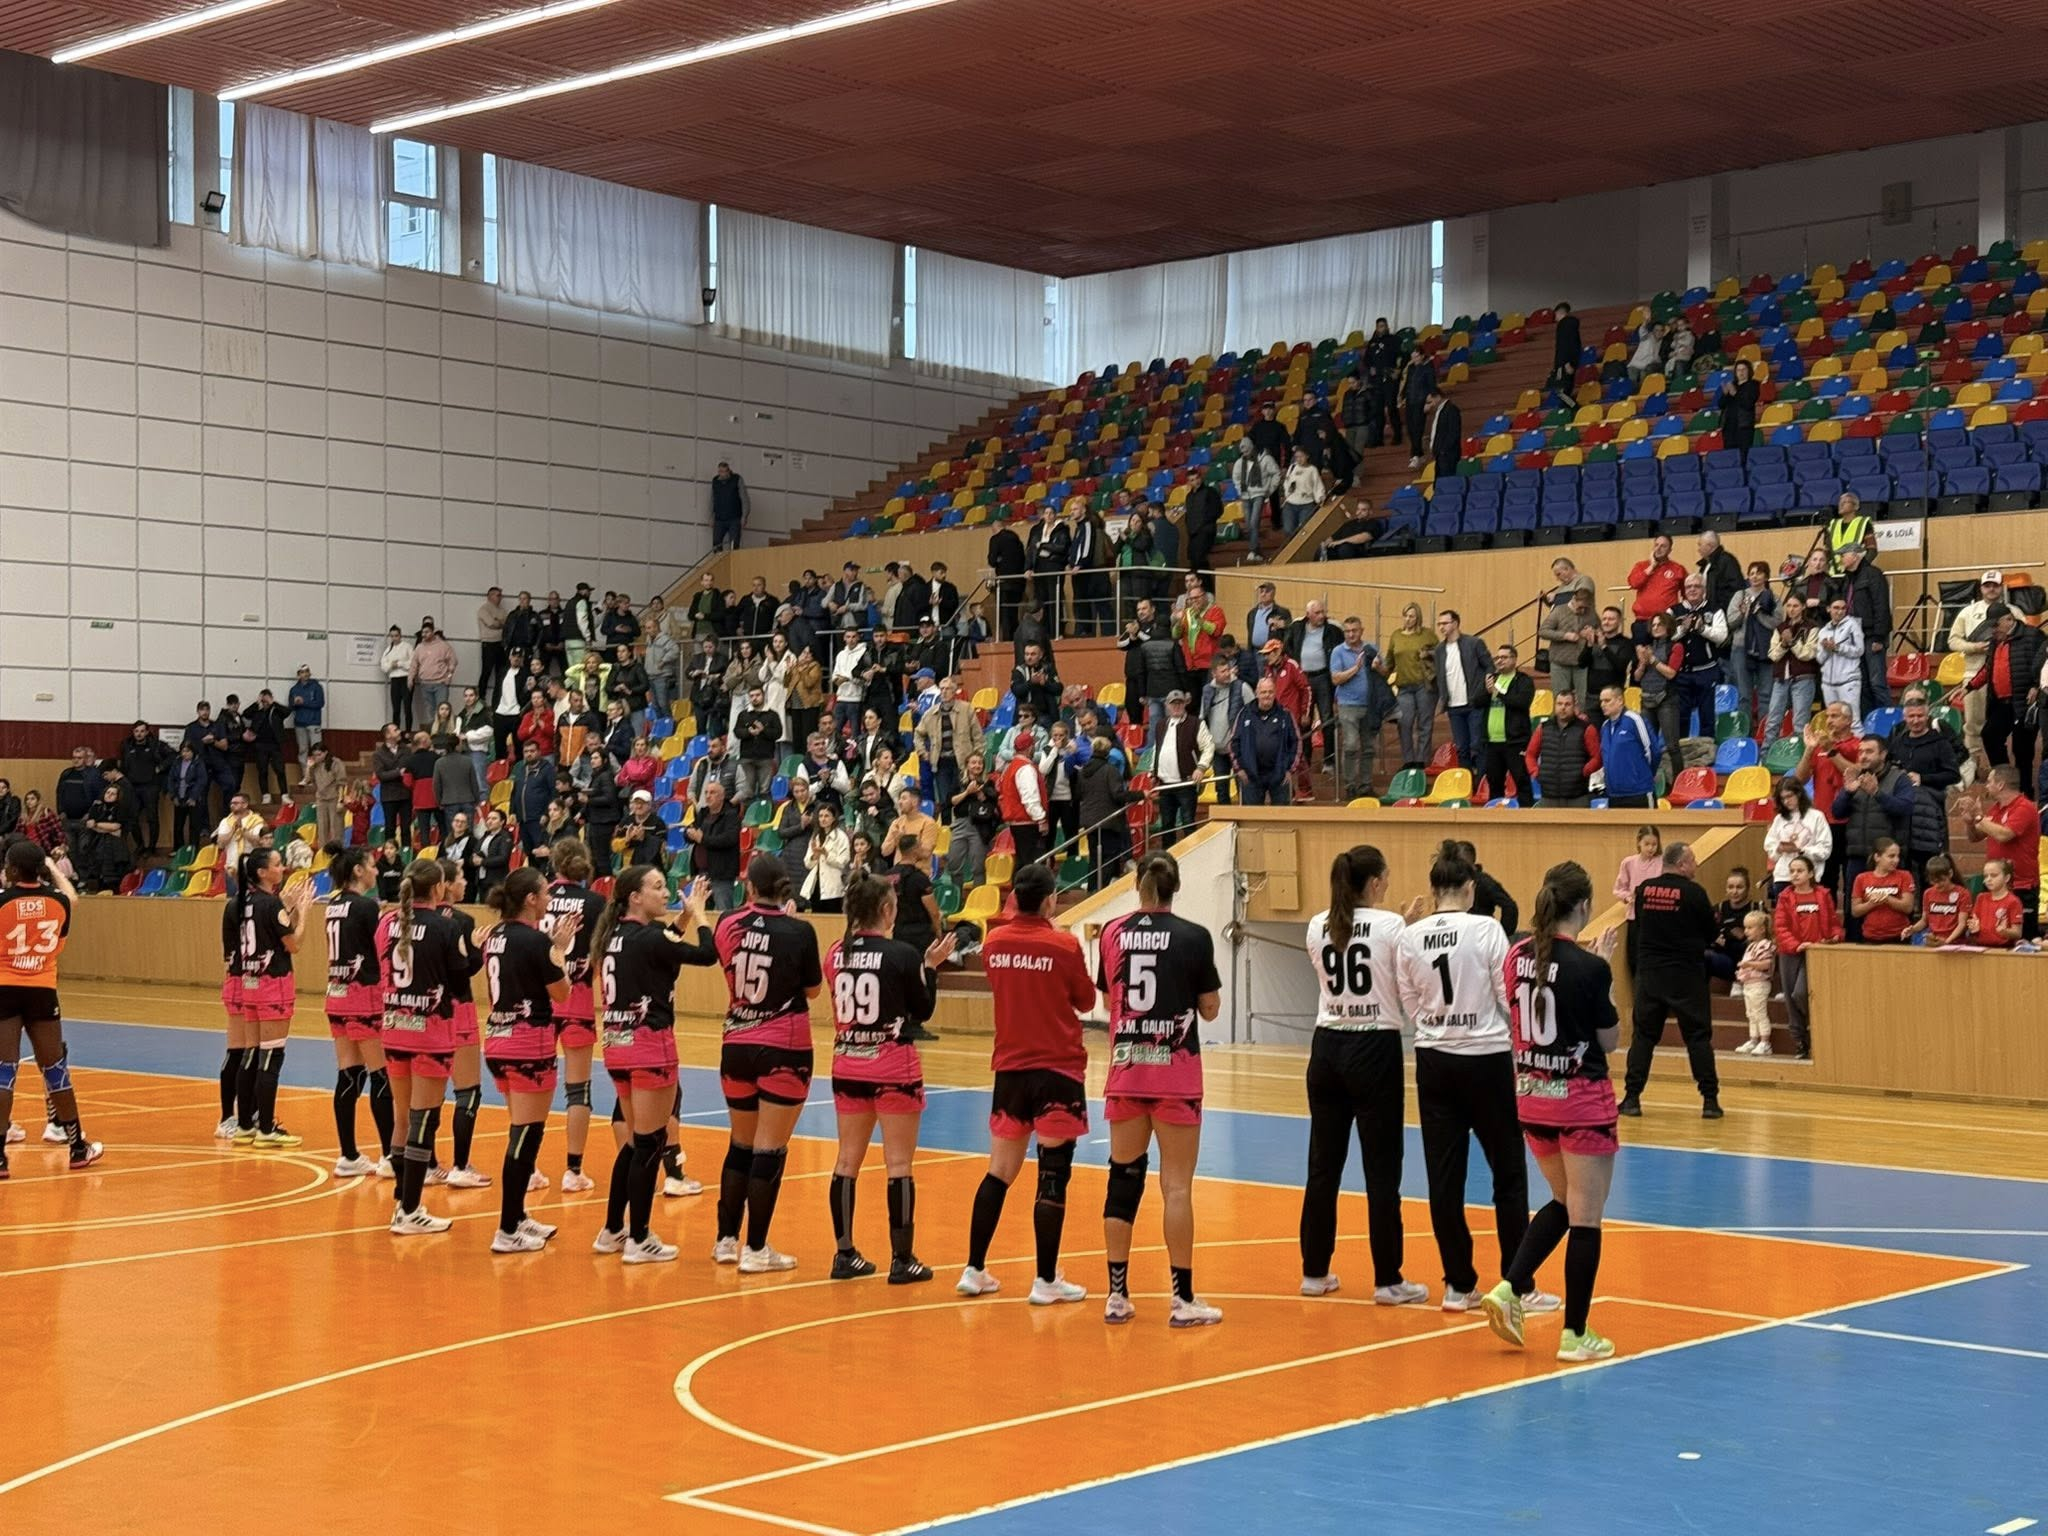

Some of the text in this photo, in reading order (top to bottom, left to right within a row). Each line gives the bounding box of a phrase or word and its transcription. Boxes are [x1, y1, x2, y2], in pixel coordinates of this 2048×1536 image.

[19, 900, 43, 911] EDS
[6, 919, 59, 955] 13
[326, 919, 340, 960] 11
[741, 931, 770, 951] JIPA
[1120, 932, 1171, 950] MARCU
[1424, 931, 1458, 950] MICU
[392, 942, 414, 988] 9
[488, 955, 500, 1006] 8
[602, 955, 616, 1005] 6
[731, 951, 773, 1004] 15
[833, 952, 883, 970] ZREAN
[989, 953, 1010, 968] CSM
[1128, 954, 1157, 1012] 5
[1322, 943, 1372, 996] 96
[1432, 953, 1454, 1006] 1
[835, 972, 880, 1025] 89
[1515, 982, 1558, 1047] 10
